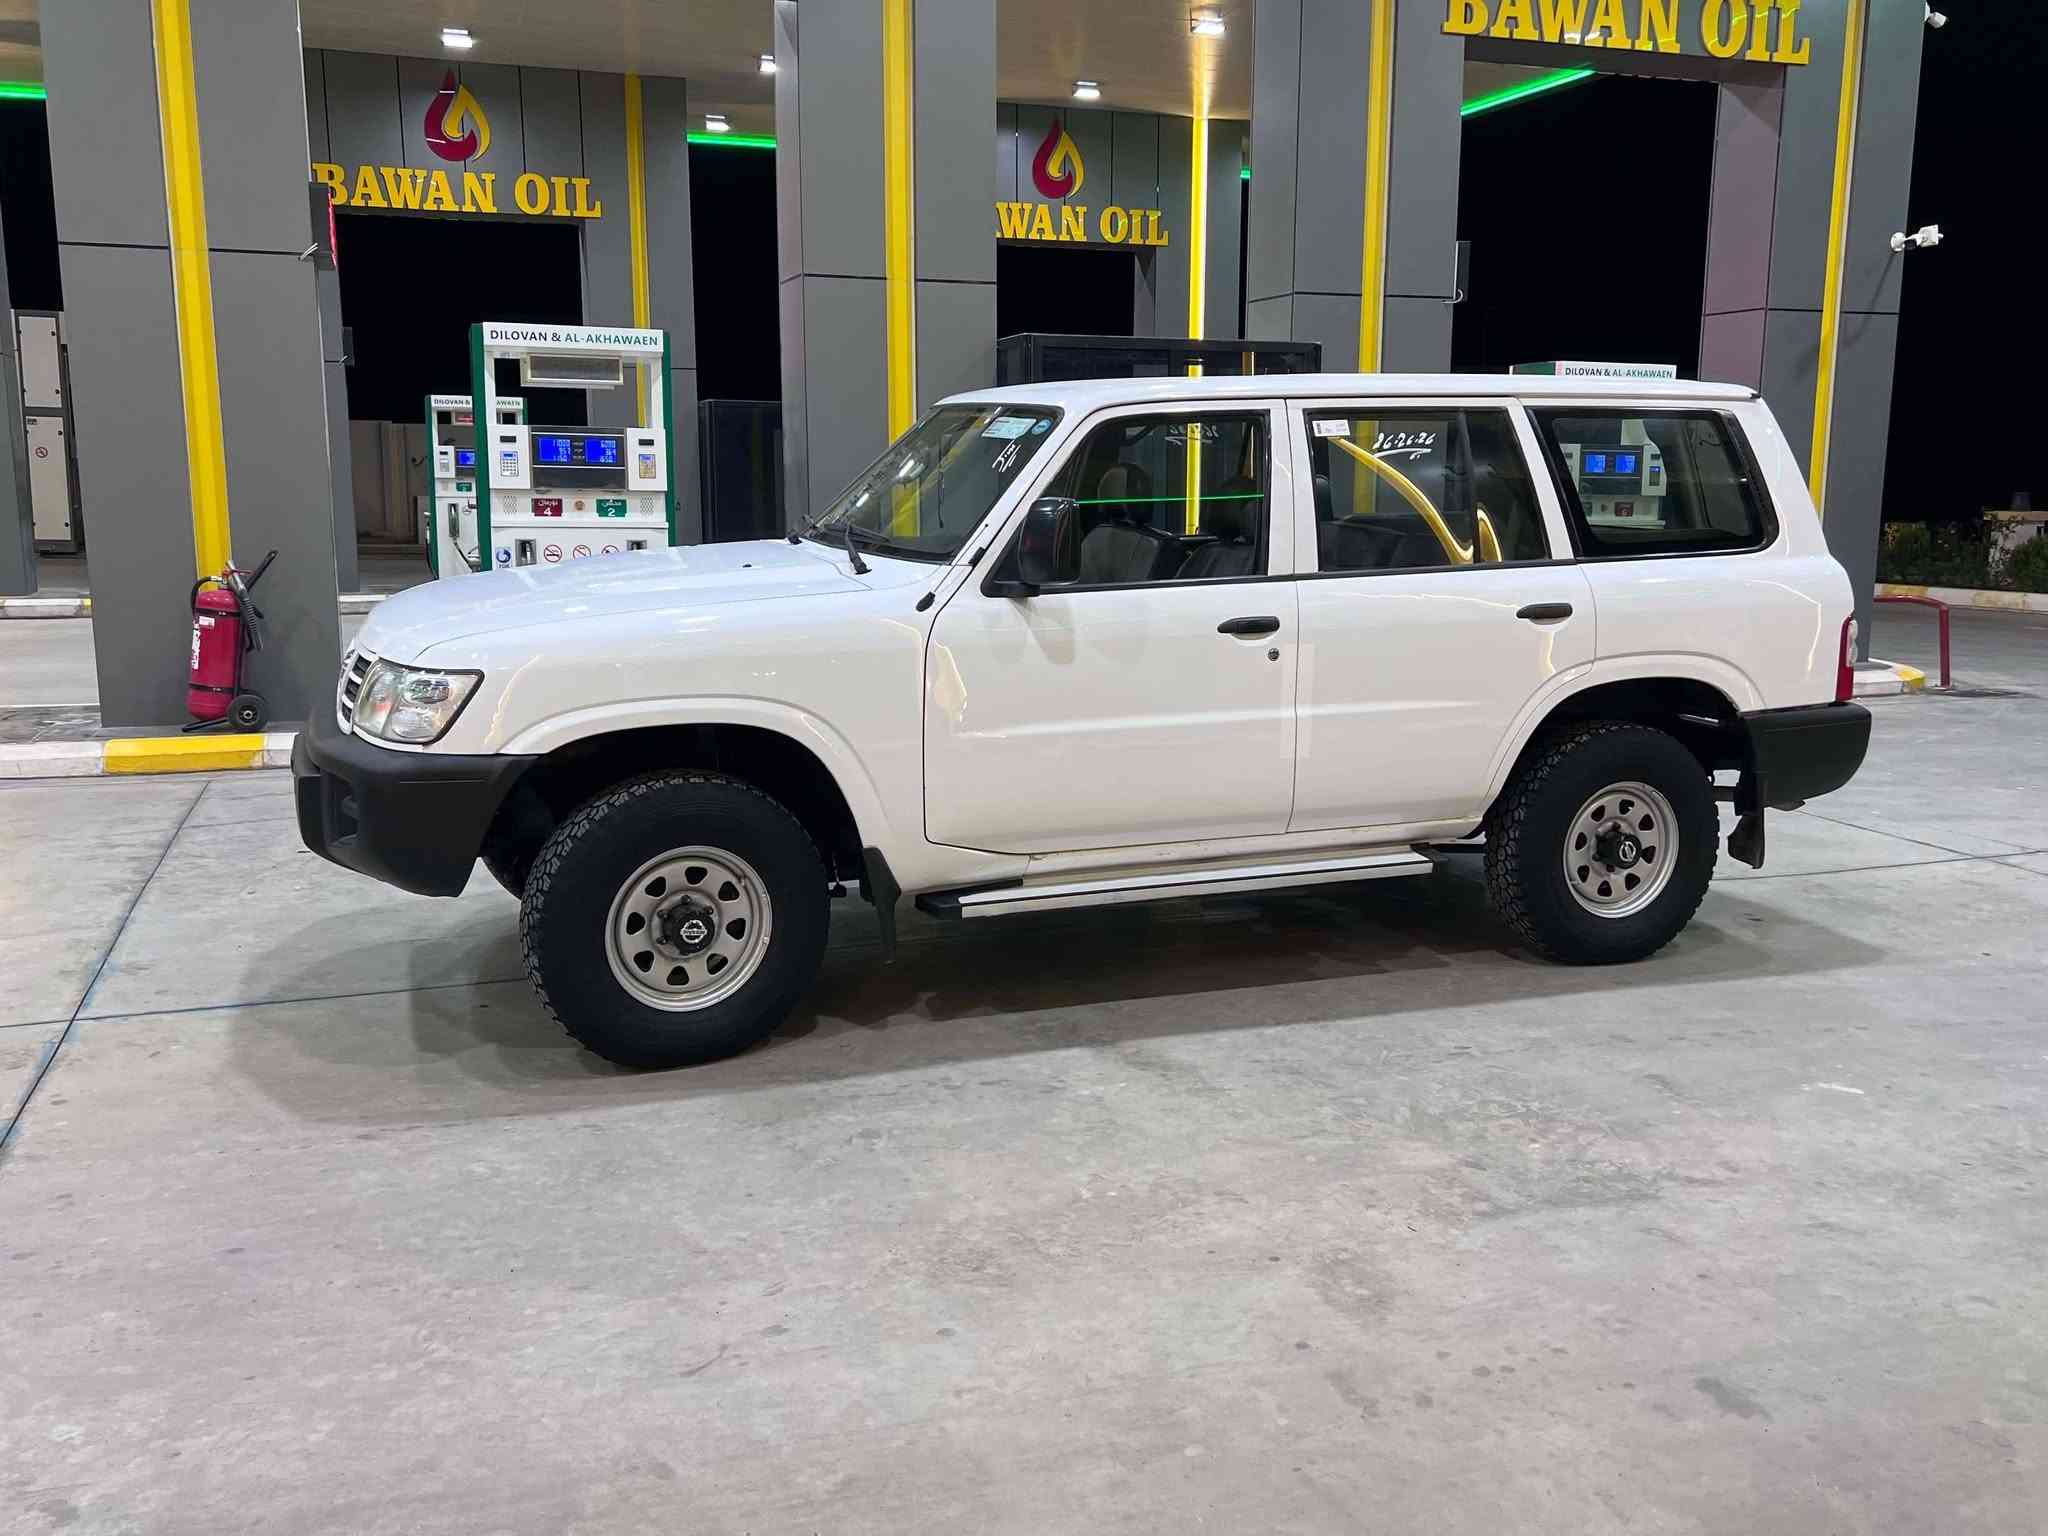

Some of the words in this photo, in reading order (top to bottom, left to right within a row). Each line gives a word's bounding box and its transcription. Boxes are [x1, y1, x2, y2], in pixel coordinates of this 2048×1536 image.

[1440, 0, 1681, 53] BAWAN
[1700, 0, 1810, 64] OIL
[312, 162, 497, 213] BAWAN
[514, 173, 601, 218] OIL
[995, 202, 1088, 241] WAN
[1100, 206, 1169, 246] OIL
[489, 329, 548, 342] DILOVAN
[551, 332, 561, 342] &
[564, 333, 658, 346] AL-AKHAWAEN
[1565, 367, 1601, 376] DILOVAN
[543, 507, 553, 516] 4
[607, 507, 616, 517] 2
